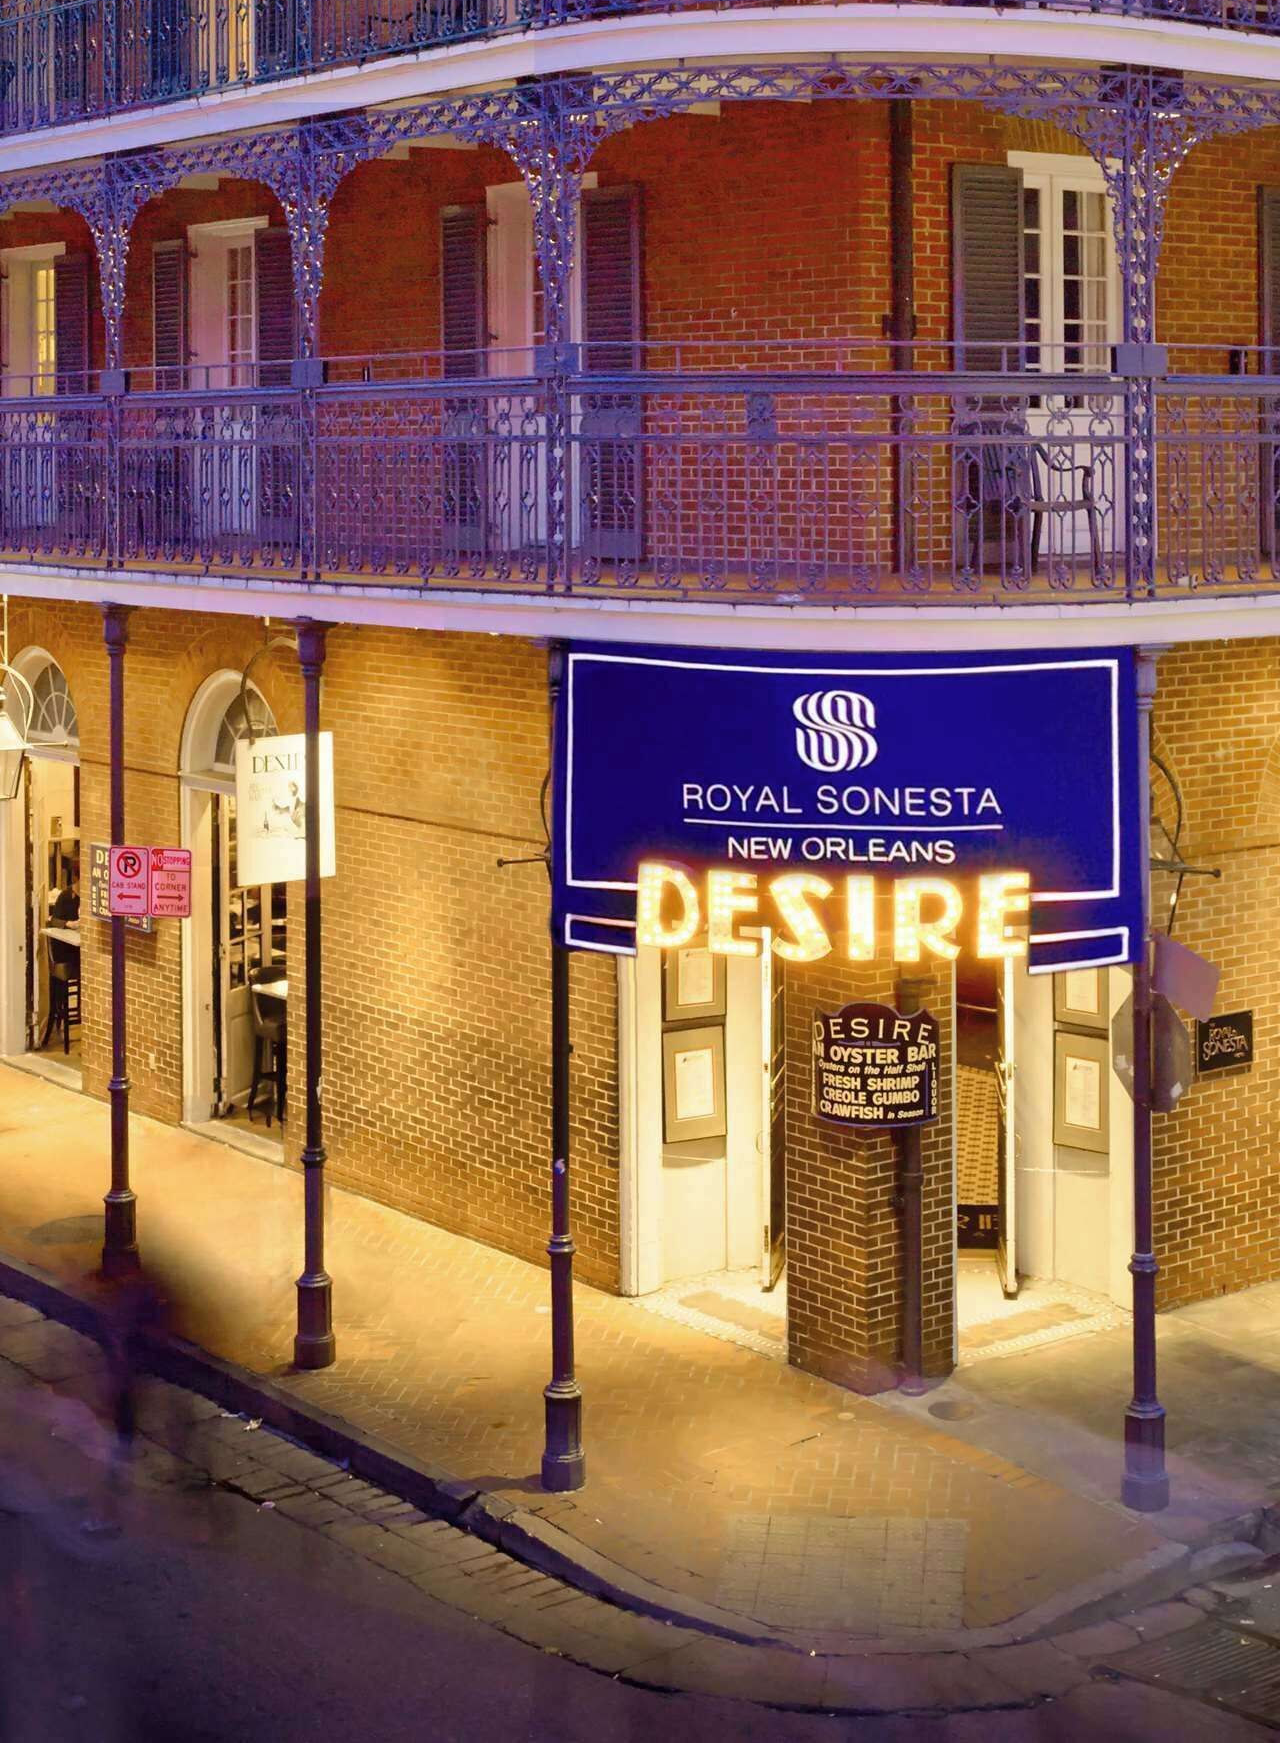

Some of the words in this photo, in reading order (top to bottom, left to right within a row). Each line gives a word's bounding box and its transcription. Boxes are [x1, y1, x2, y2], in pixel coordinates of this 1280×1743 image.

[683, 784, 802, 814] ROYAL
[817, 785, 1002, 816] SONESTA
[152, 853, 163, 866] NO
[163, 856, 191, 866] STOPPING
[728, 837, 792, 859] NEW
[802, 837, 956, 864] ORLEANS
[112, 881, 124, 889] CAB
[127, 881, 146, 890] STAND
[166, 873, 176, 881] TO
[155, 883, 187, 891] CORNER
[153, 904, 188, 913] ANYTIME
[636, 861, 1031, 963] DESIRE
[814, 1018, 932, 1045] DESIRE
[830, 1045, 899, 1064] OYSTER
[907, 1043, 936, 1062] BAR
[1202, 1035, 1249, 1061] SONESTA
[819, 1058, 845, 1072] Oysters
[848, 1065, 860, 1074] on
[864, 1065, 880, 1075] the
[884, 1064, 904, 1074] Half
[906, 1061, 926, 1073] Shell
[823, 1073, 860, 1090] FRESH
[867, 1076, 919, 1091] SHRIMP
[823, 1087, 866, 1104] CREOLE
[872, 1090, 920, 1105] GUMBO
[820, 1099, 883, 1119] CRAWFISH
[897, 1109, 924, 1118] Season
